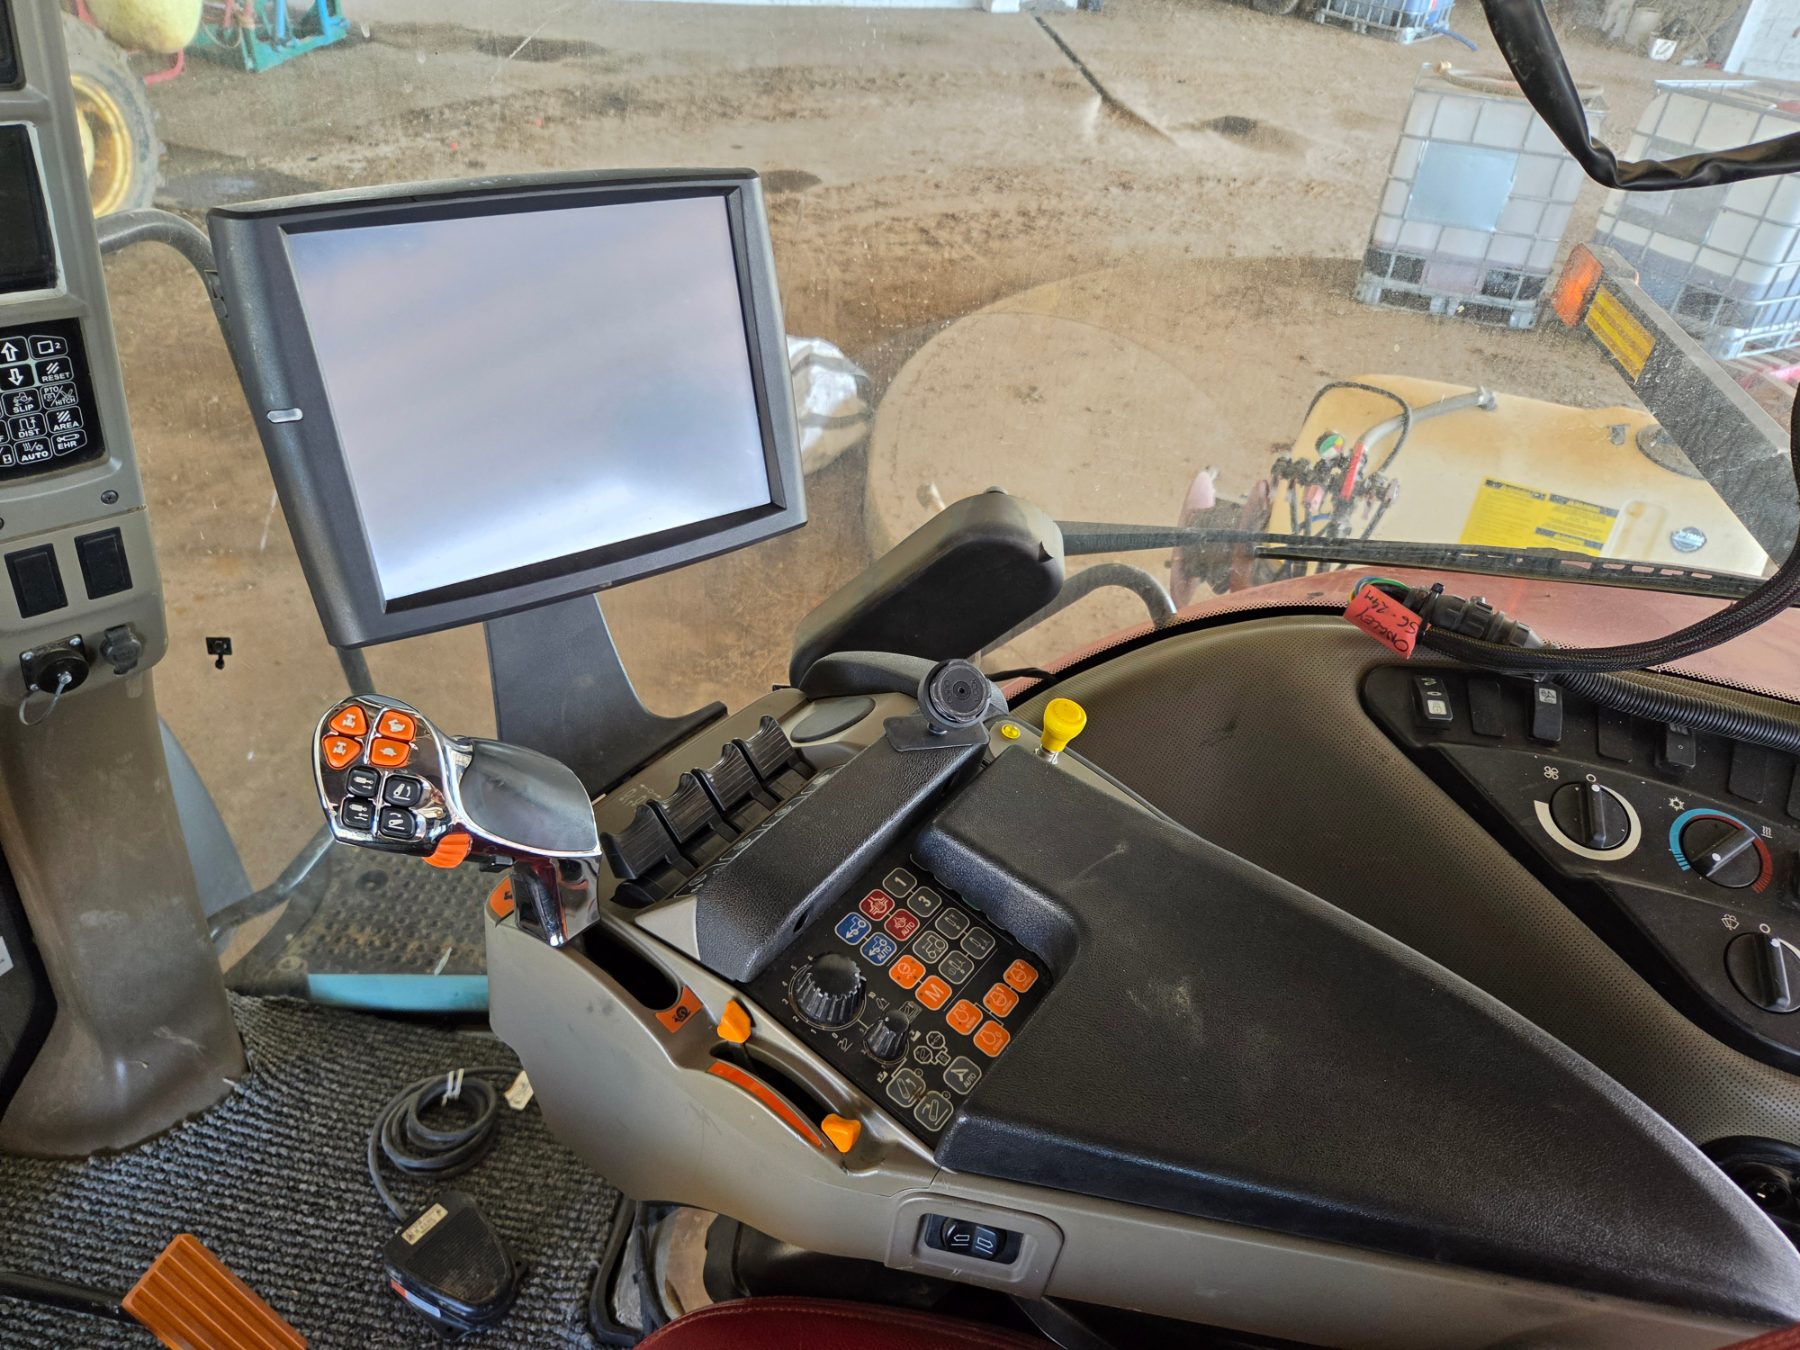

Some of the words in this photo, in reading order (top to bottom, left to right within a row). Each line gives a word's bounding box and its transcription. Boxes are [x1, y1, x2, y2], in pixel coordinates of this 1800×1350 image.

[41, 372, 71, 382] RESET
[44, 386, 59, 394] PTO
[55, 397, 76, 406] HITCH
[13, 404, 34, 414] SLIP
[53, 421, 80, 431] AREA
[18, 428, 40, 438] DIST
[57, 440, 78, 450] EHR
[21, 451, 49, 462] AUTO
[894, 876, 907, 887] 1
[918, 895, 932, 908] 3
[901, 921, 916, 936] AUTO
[877, 944, 893, 961] AUTO
[924, 983, 944, 1002] M
[792, 1015, 800, 1023] 2
[963, 1073, 977, 1088] AUTO
